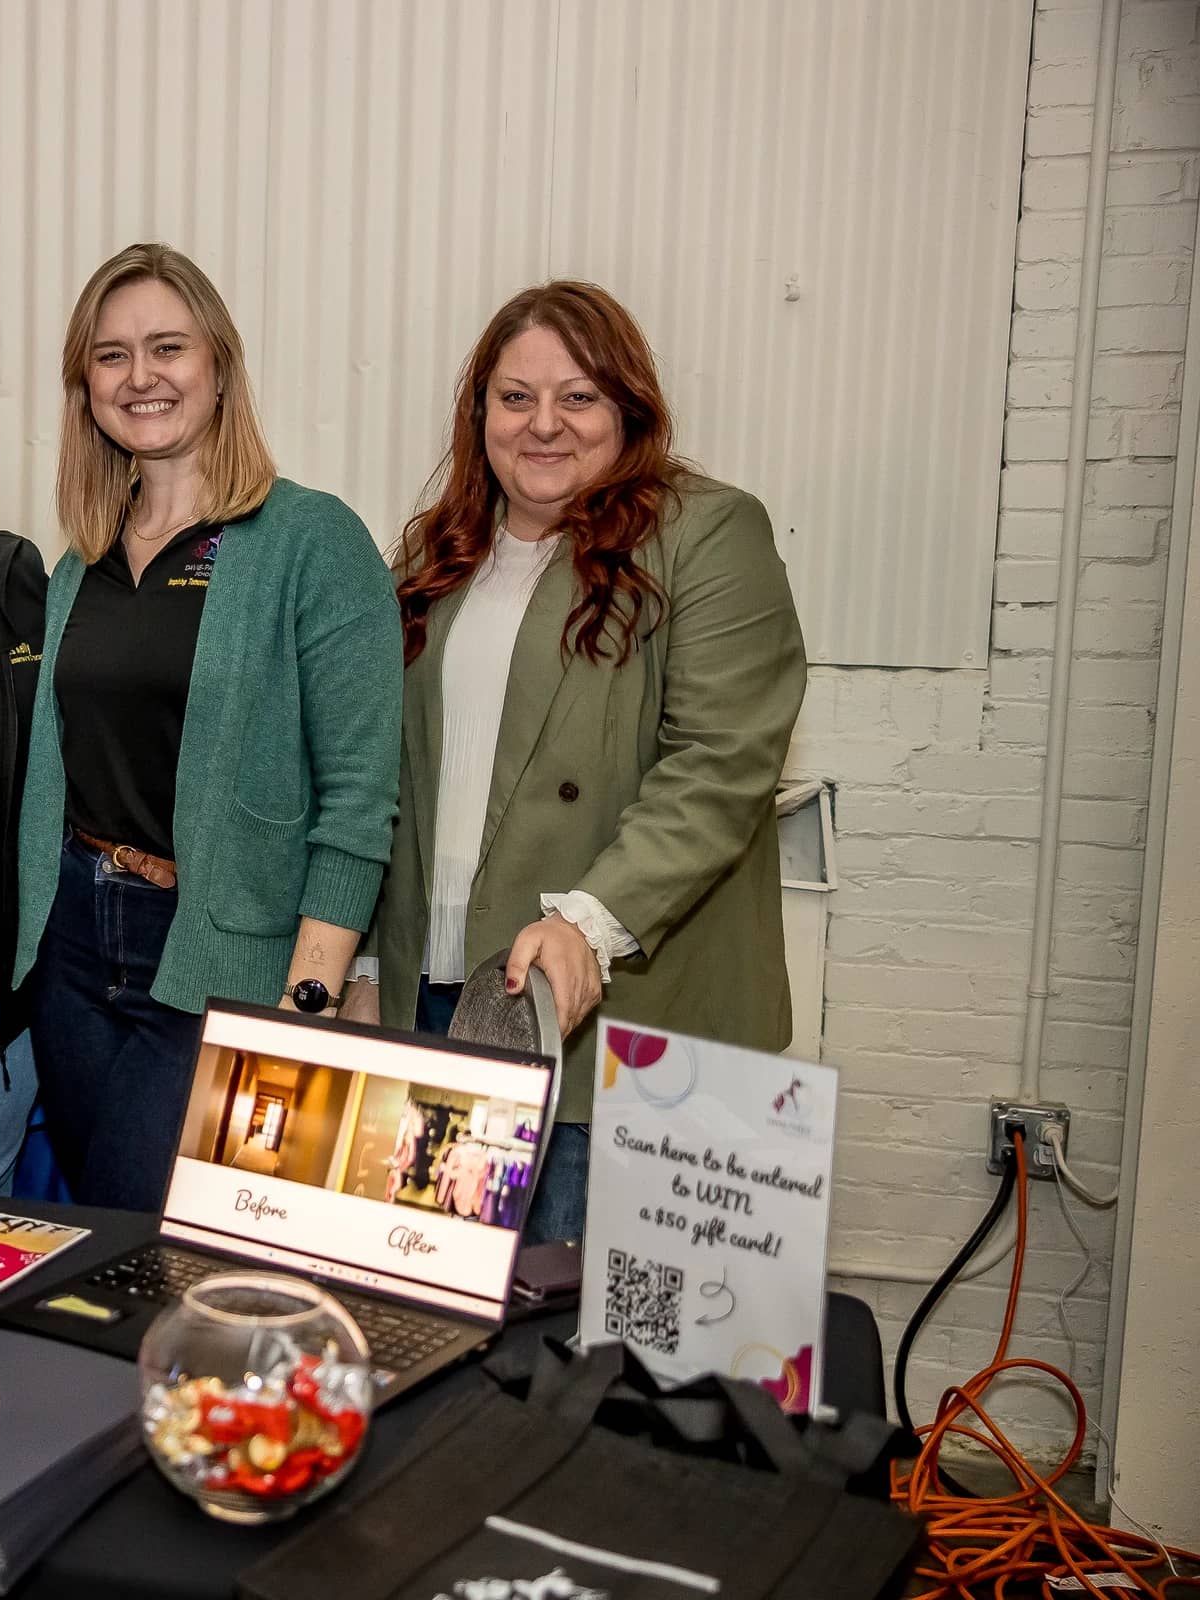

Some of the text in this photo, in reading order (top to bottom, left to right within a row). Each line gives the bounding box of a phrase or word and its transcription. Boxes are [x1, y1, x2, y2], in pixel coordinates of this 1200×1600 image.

[613, 1125, 823, 1200] Scan here to be entered
[234, 1189, 288, 1220] Before
[671, 1178, 754, 1216] to WIN
[387, 1224, 438, 1255] After
[639, 1207, 783, 1259] a $50 gift card!
